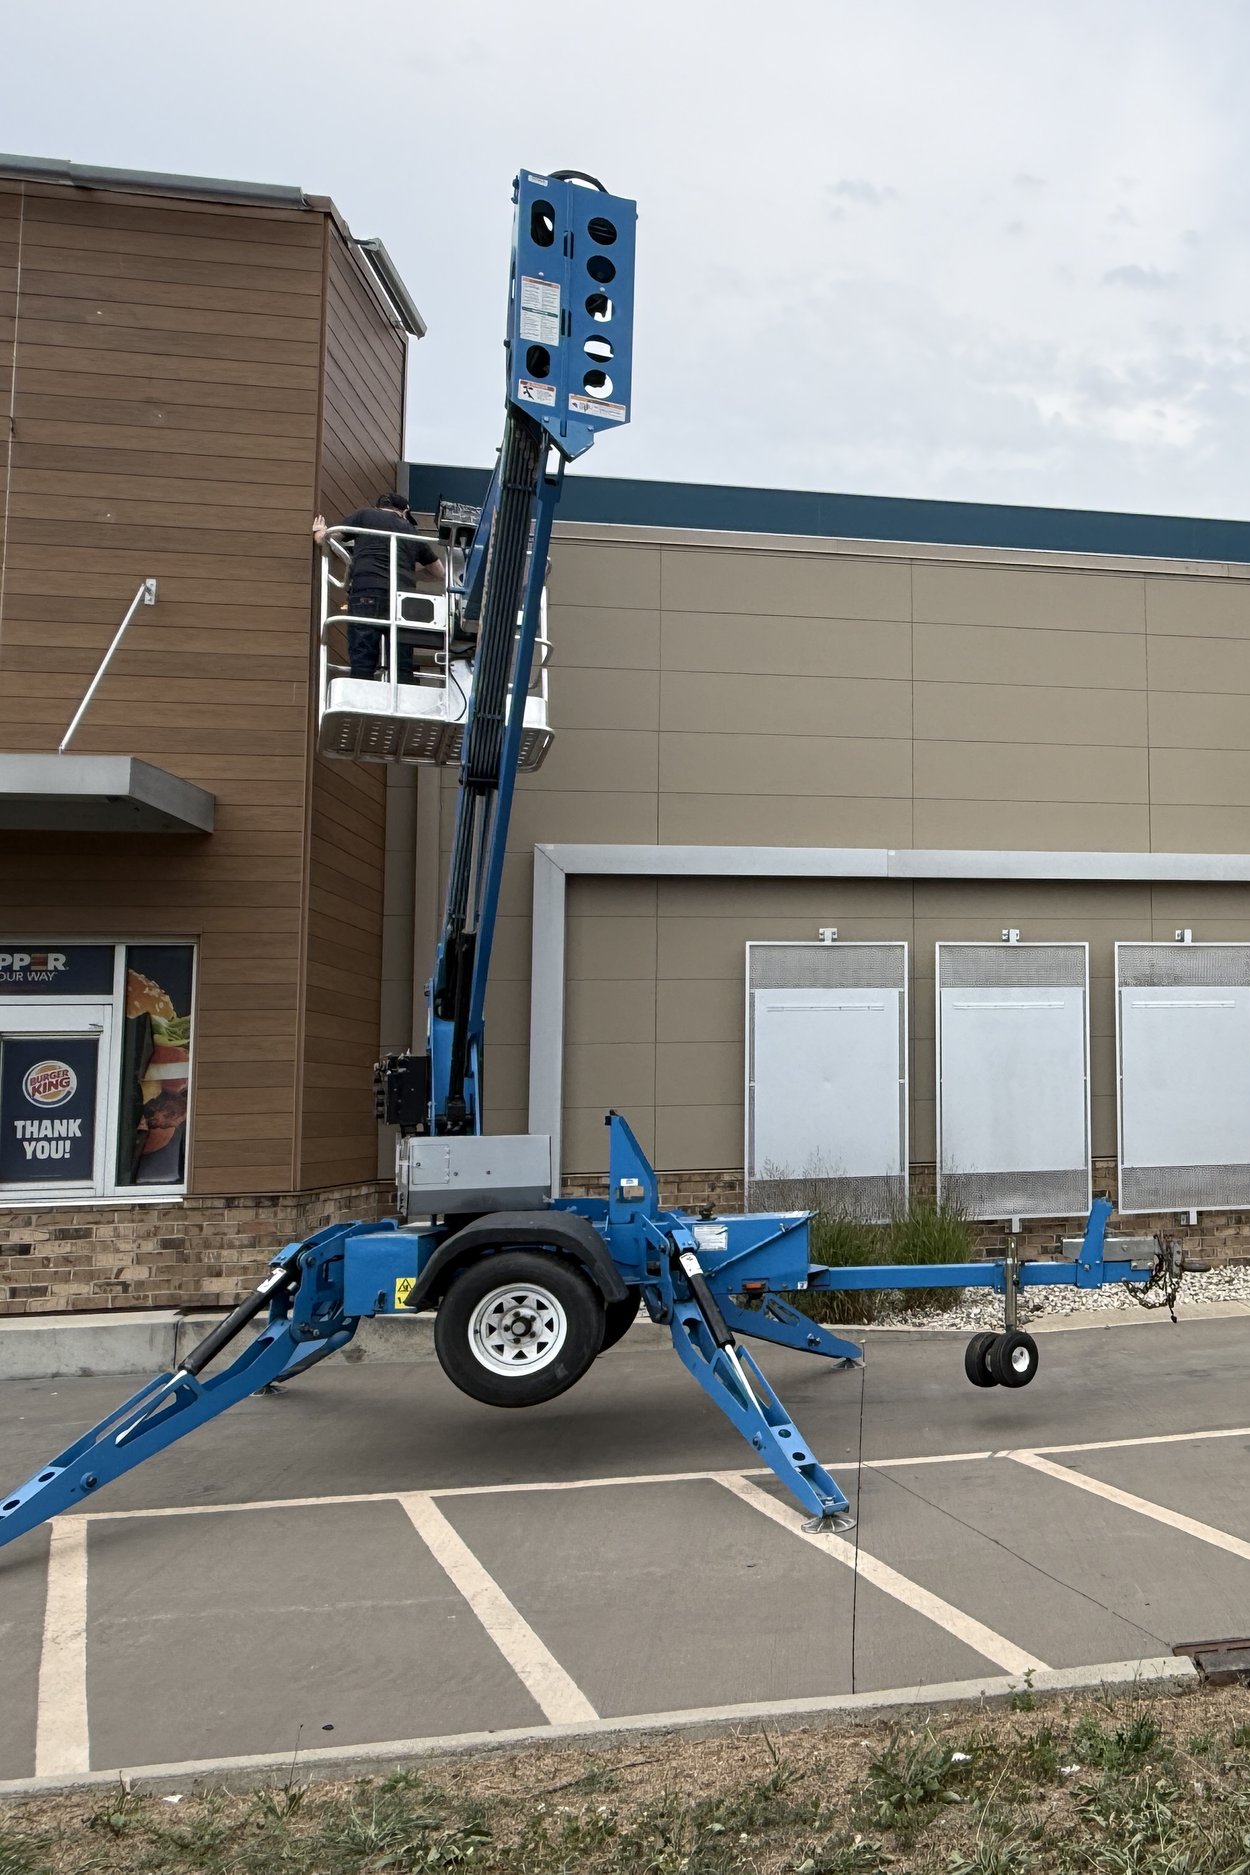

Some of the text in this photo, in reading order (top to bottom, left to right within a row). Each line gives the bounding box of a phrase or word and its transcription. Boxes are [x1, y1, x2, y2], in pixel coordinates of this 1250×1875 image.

[27, 971, 56, 981] WAY
[30, 1069, 69, 1087] BURGER
[31, 1077, 70, 1098] KING
[14, 1119, 82, 1138] THANK
[23, 1140, 71, 1159] YOU!
